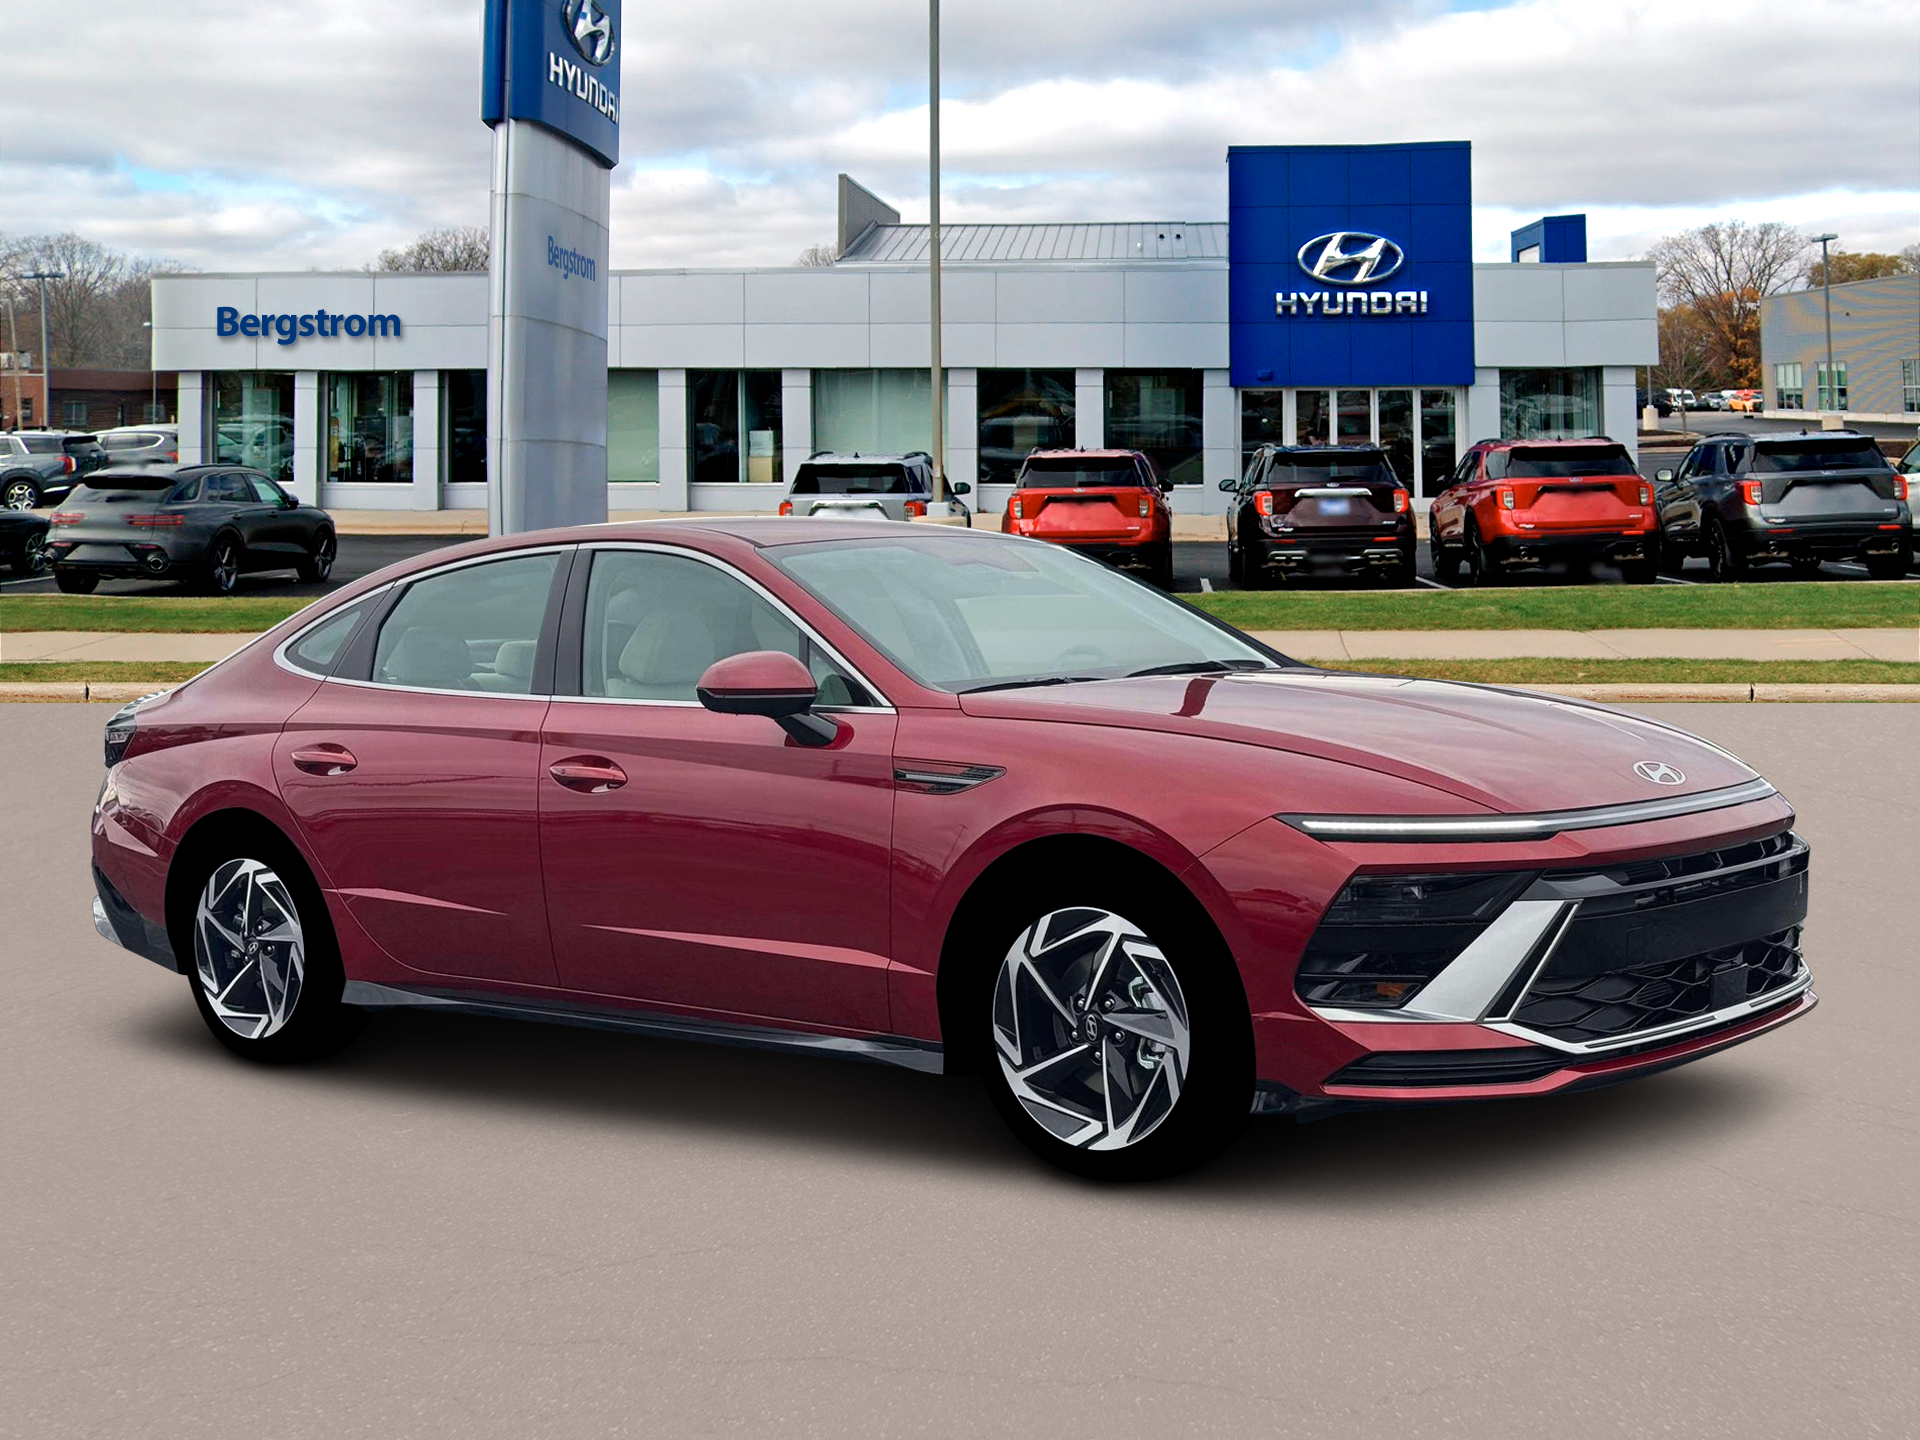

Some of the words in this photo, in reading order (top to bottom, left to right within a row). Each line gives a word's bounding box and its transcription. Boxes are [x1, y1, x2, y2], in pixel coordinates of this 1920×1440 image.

[548, 52, 618, 124] HYUNDAI
[547, 235, 596, 281] Bergstrom
[1275, 291, 1428, 315] HYUNDAI
[217, 306, 401, 345] Bergstrom
